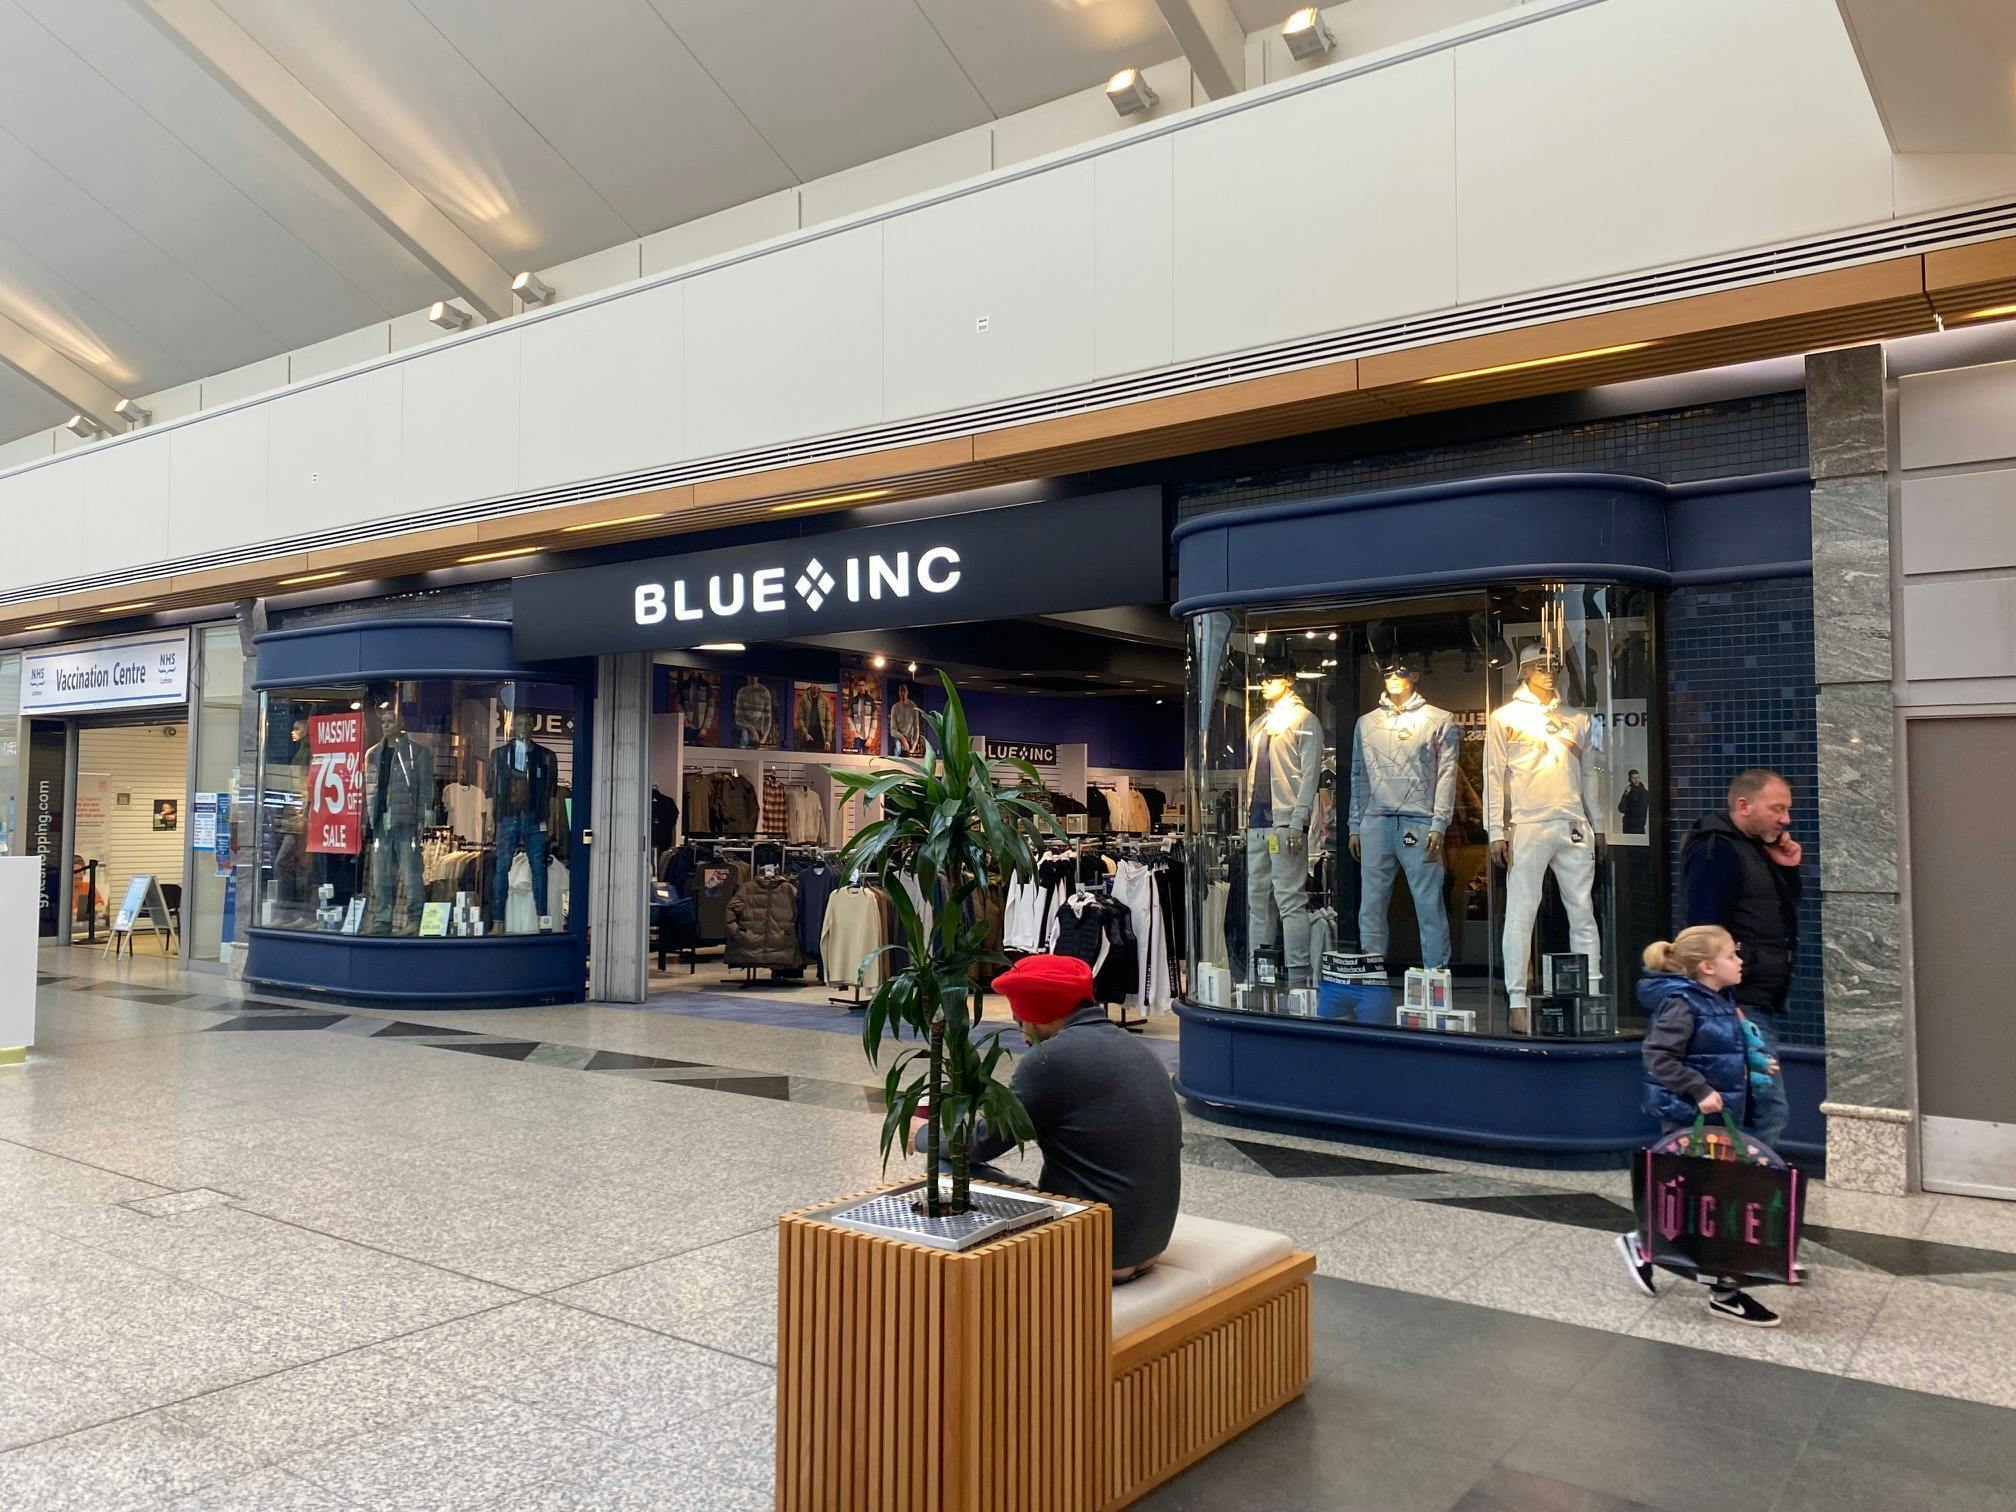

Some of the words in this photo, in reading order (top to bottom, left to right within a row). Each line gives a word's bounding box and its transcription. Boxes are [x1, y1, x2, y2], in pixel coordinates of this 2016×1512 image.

[634, 567, 786, 625] BLUE
[846, 546, 961, 602] INC
[160, 653, 176, 666] NHS
[31, 668, 45, 679] NHS
[56, 664, 109, 691] Vaccination
[113, 662, 146, 686] Centre
[318, 720, 356, 744] MASSIVE
[985, 745, 1018, 758] LUE
[1029, 748, 1053, 761] INC
[322, 824, 347, 848] SALE
